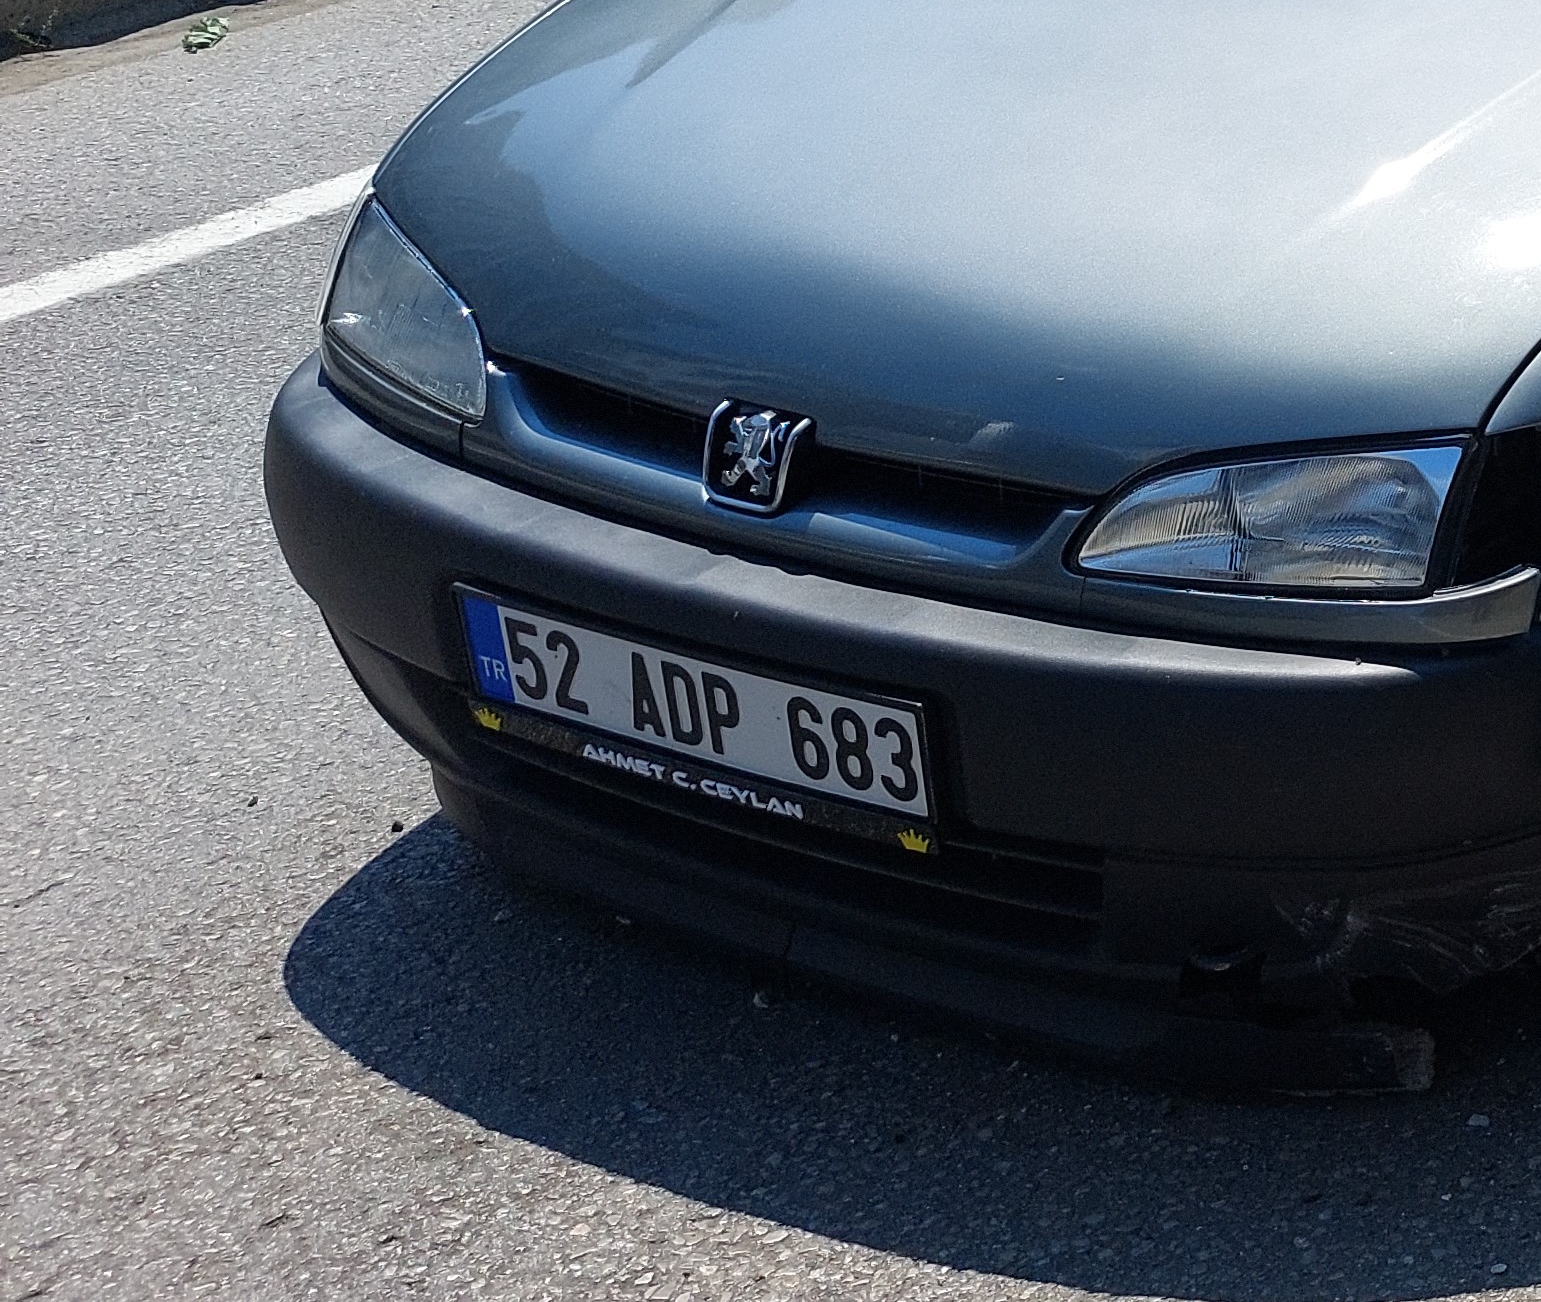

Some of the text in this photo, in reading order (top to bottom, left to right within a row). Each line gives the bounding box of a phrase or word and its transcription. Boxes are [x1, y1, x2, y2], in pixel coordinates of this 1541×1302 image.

[479, 655, 506, 682] TR
[504, 616, 919, 802] 52 ADP 683
[582, 743, 804, 820] AHMET C. CEYLAN
